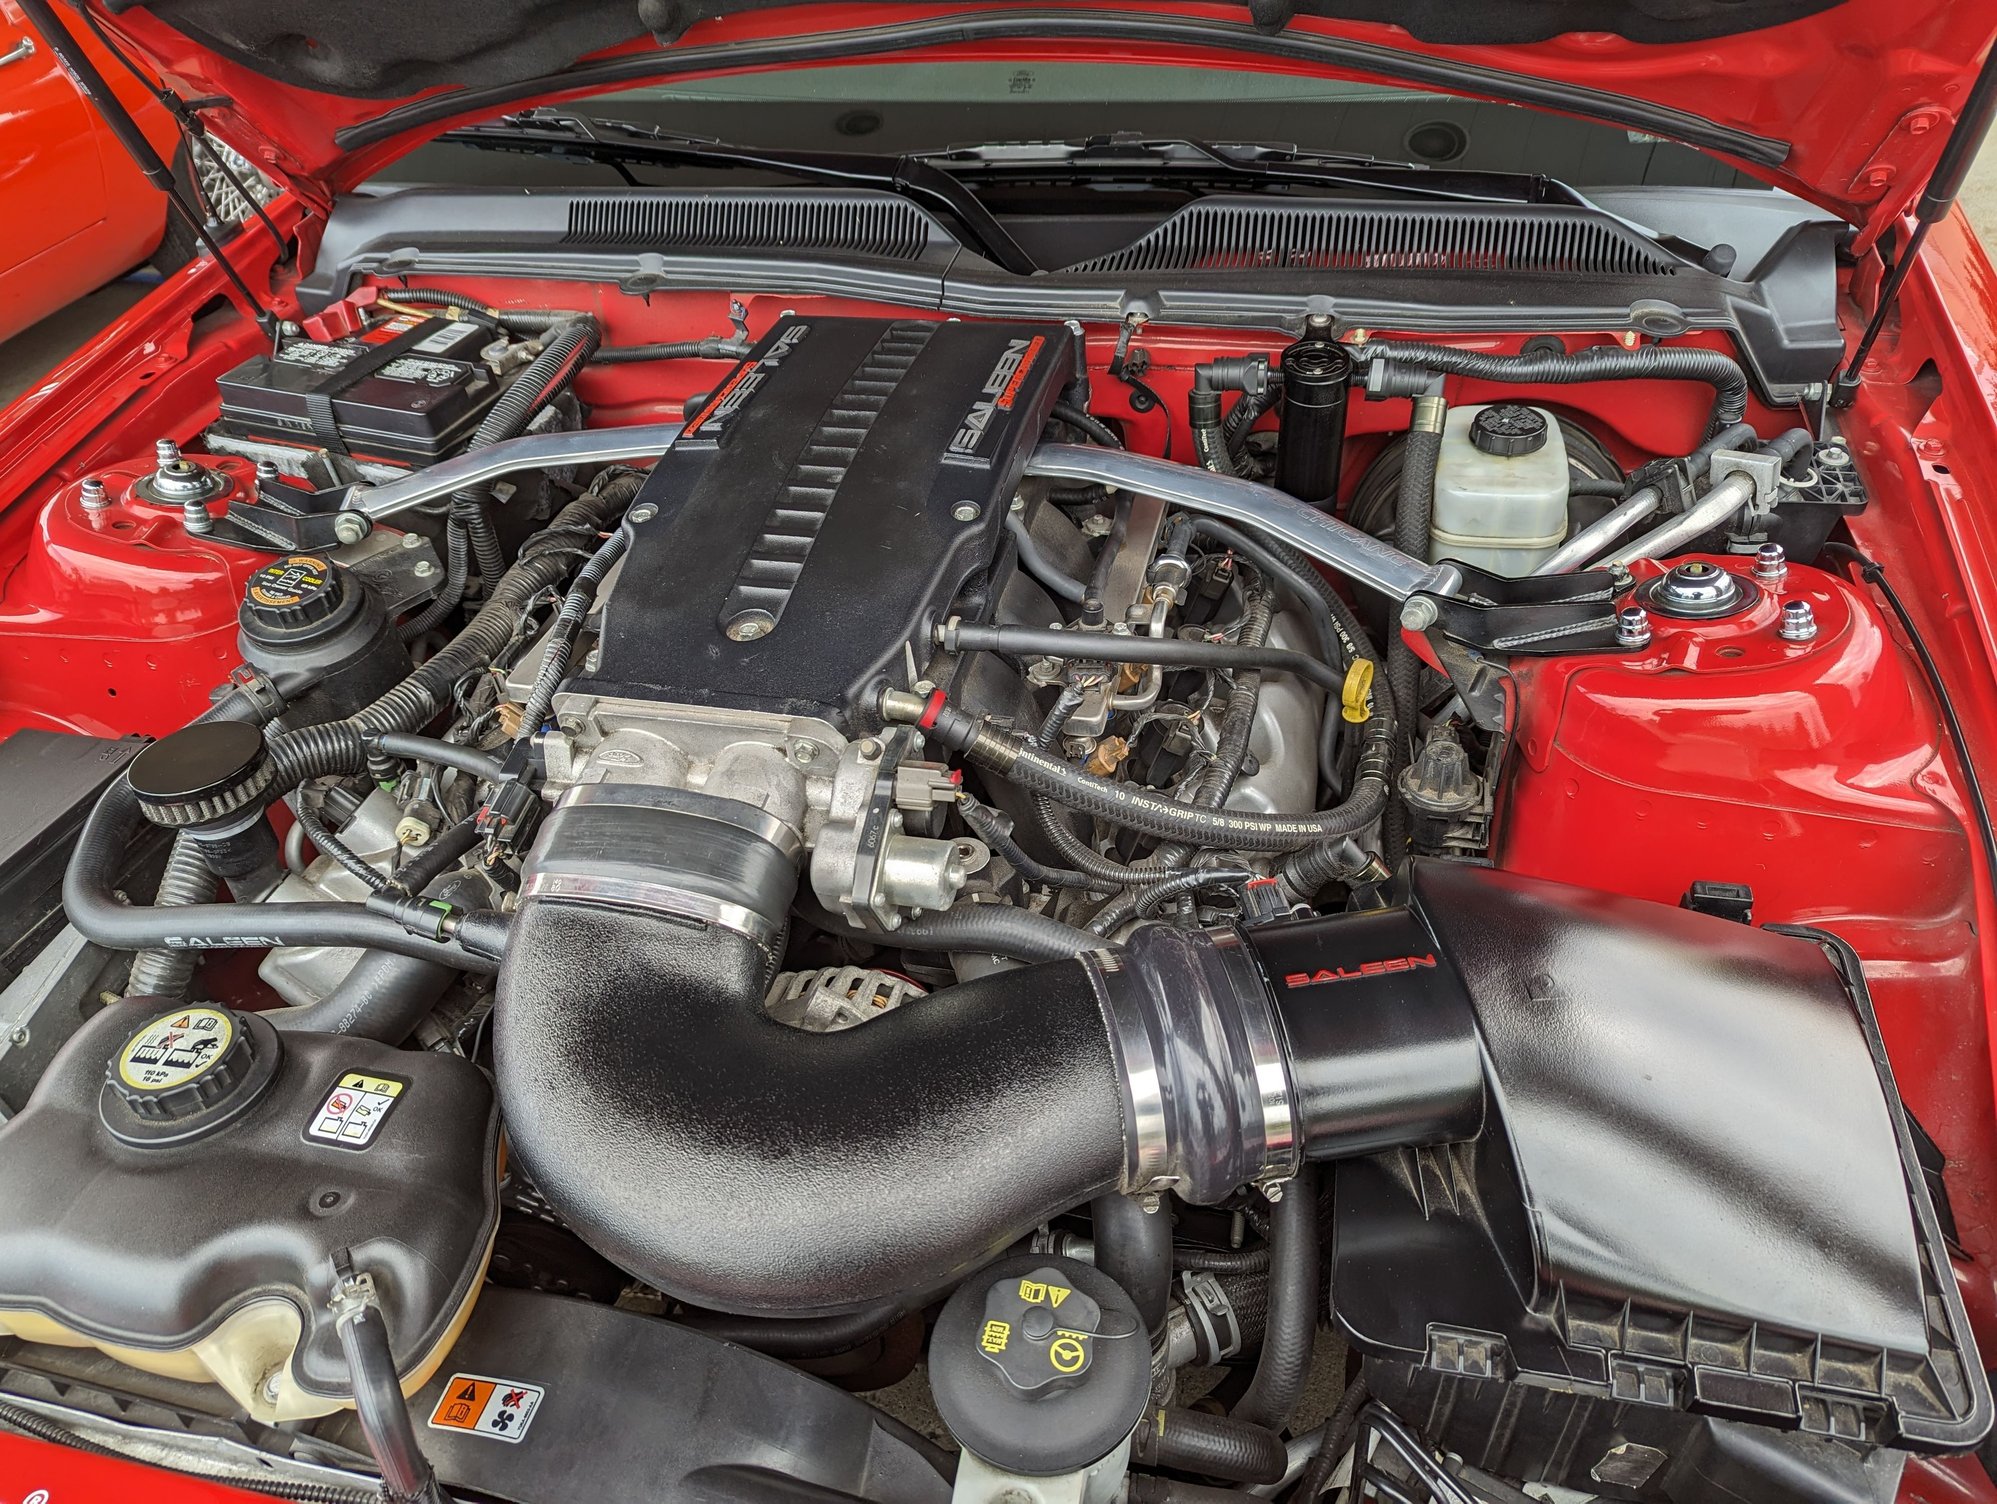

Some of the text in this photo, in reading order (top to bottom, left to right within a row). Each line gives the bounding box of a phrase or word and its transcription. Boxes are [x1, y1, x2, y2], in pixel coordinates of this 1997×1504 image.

[699, 325, 809, 432] SALEEN
[949, 338, 1031, 454] SALEEN
[267, 568, 285, 576] INTER
[302, 576, 323, 585] COOLER
[1077, 776, 1108, 794] ContiTech
[1114, 790, 1126, 801] 10
[1194, 813, 1207, 823] TC
[1212, 817, 1225, 827] 5/8
[1228, 819, 1243, 830] 300
[1244, 821, 1258, 831] PSI
[1258, 823, 1272, 832] WP
[1275, 824, 1298, 833] MADE
[1298, 824, 1307, 833] IN
[1307, 824, 1323, 833] USA
[163, 935, 286, 948] SALEEN
[1285, 953, 1437, 988] SALEEN
[200, 1053, 213, 1061] OK
[144, 1069, 155, 1077] 110
